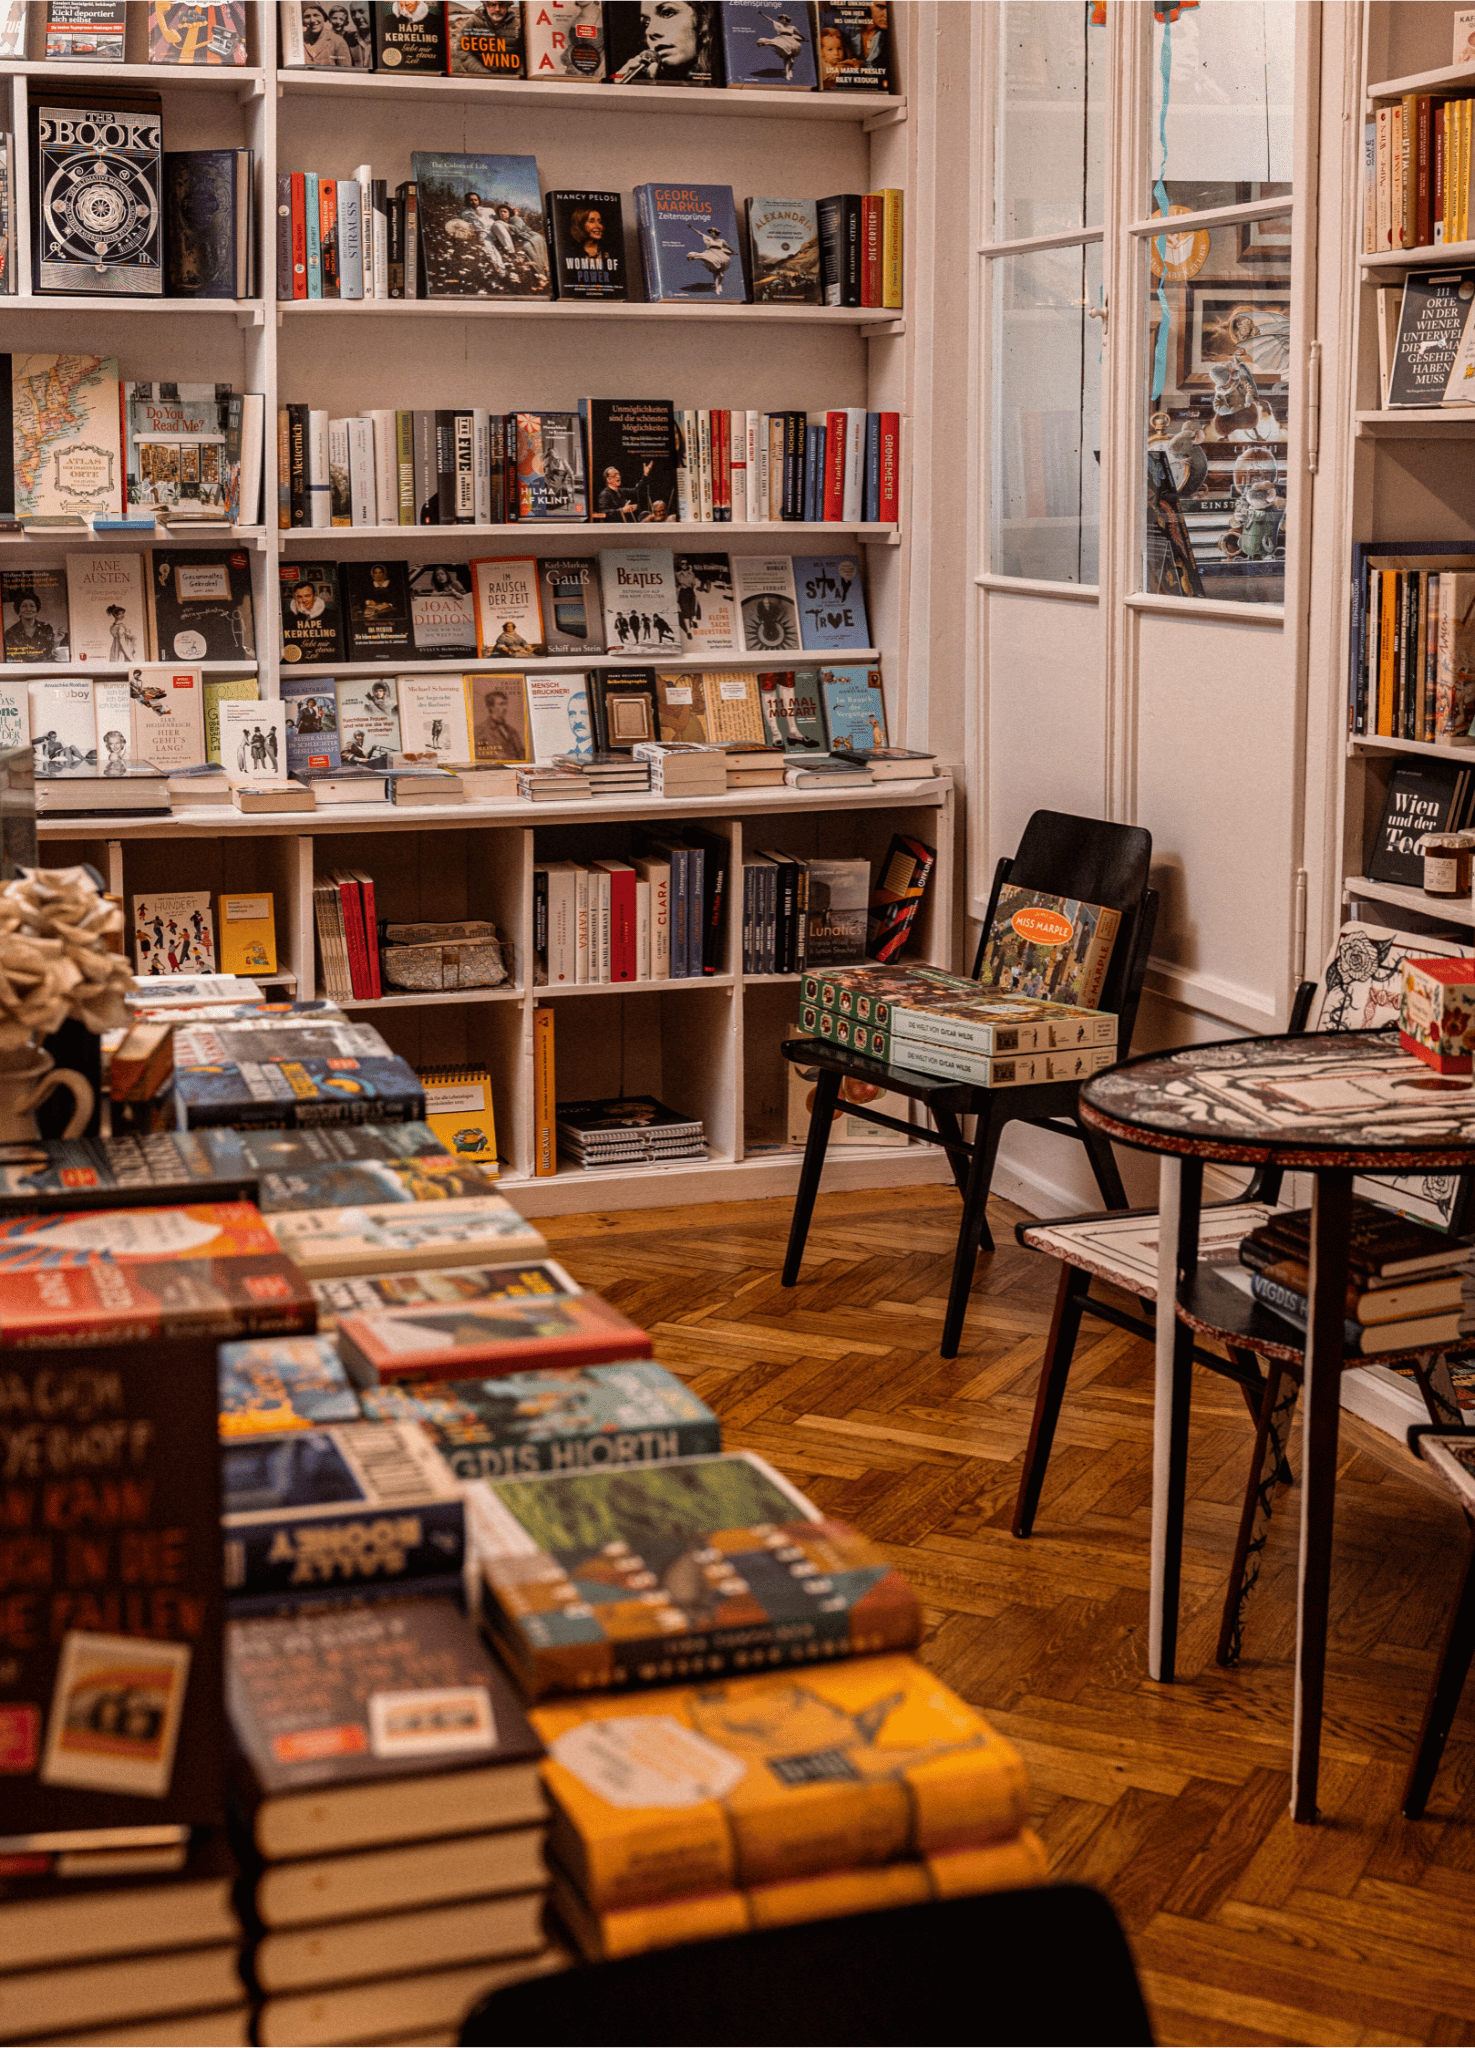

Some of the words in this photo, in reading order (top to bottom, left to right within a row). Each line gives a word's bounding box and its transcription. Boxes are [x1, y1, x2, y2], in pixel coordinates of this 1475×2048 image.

[74, 10, 114, 18] deportiert
[398, 24, 424, 33] HAPE
[385, 33, 438, 43] KERKELING
[461, 37, 506, 52] GEGEN
[482, 52, 520, 68] WIND
[853, 77, 878, 85] KEOUGH
[87, 113, 114, 122] THE
[55, 121, 151, 149] BOOK
[655, 190, 698, 201] GEORG
[656, 201, 713, 214] MARKUS
[658, 213, 712, 222] Zeitensprünge
[346, 201, 358, 258] STRAUSS
[869, 211, 877, 246] CARTIERS
[310, 252, 318, 269] Hedy
[868, 248, 877, 261] DIE
[566, 257, 604, 270] WOMAN
[607, 259, 619, 272] OF
[577, 271, 610, 283] POWER
[1436, 288, 1450, 297] 111
[1427, 298, 1457, 308] ORTE
[1422, 310, 1434, 319] IN
[1436, 308, 1458, 318] DER
[1417, 319, 1460, 330] WIENER
[1403, 329, 1462, 342] UNTERWEL
[1401, 343, 1420, 353] DIE
[1442, 341, 1460, 350] MA
[1408, 352, 1457, 363] GESEHEN
[1412, 362, 1450, 374] HABEN
[1415, 374, 1445, 384] MUSS
[146, 407, 162, 419] Do
[163, 406, 184, 420] You
[612, 405, 668, 414] Unmöglichkeiten
[636, 414, 668, 422] schönsten
[153, 420, 179, 432] Read
[182, 420, 205, 432] Me?
[622, 424, 668, 433] Möglichkeiten
[292, 424, 303, 475] Metternich
[459, 437, 471, 471] FIVE
[400, 463, 413, 507] BRUCKNER
[537, 496, 568, 504] KLINT
[92, 560, 120, 572] JANE
[545, 561, 589, 569] Karl-Markus
[83, 572, 130, 583] AUSTEN
[502, 573, 511, 581] IM
[546, 569, 590, 585] Gauß
[617, 567, 663, 588] BEATLES
[489, 581, 526, 593] RAUSCH
[805, 568, 852, 603] STAY
[488, 594, 507, 605] DER
[510, 593, 529, 604] ZEIT
[1352, 578, 1360, 627] STEPHANSDOM
[421, 600, 463, 612] JOAN
[297, 620, 322, 629] HAPE
[414, 614, 472, 625] DIDION
[284, 629, 336, 638] KERKELING
[767, 699, 785, 708] 111
[788, 697, 816, 707] MAL
[769, 707, 817, 718] MOZART
[1395, 793, 1439, 817] Wien
[1388, 815, 1413, 828] und
[1414, 816, 1436, 830] der
[154, 900, 198, 912] HUNDERT
[658, 880, 667, 925] CLARA
[579, 911, 587, 948] KAFKA
[810, 922, 862, 936] Lunatics
[1015, 915, 1035, 929] MISS
[1035, 921, 1069, 938] MARPLE
[542, 1128, 550, 1148] XVIII
[542, 1150, 550, 1169] BRG
[1253, 1274, 1298, 1312] VIGDIS
[451, 1444, 540, 1480] GDIS
